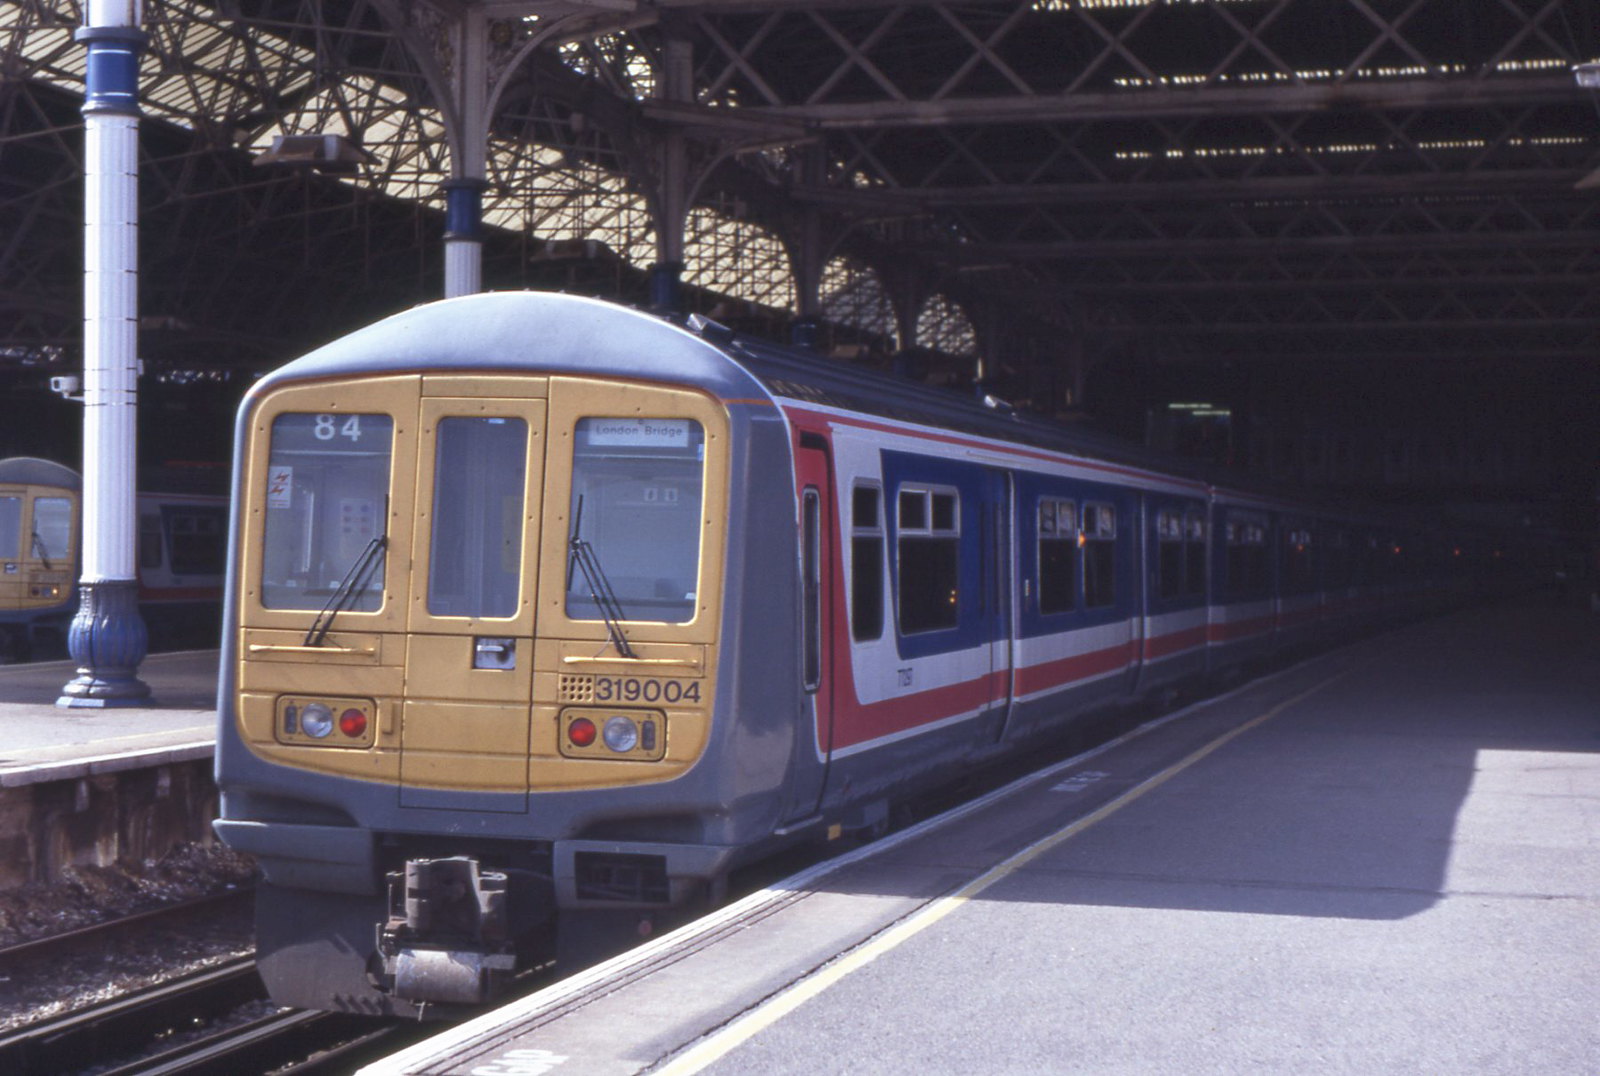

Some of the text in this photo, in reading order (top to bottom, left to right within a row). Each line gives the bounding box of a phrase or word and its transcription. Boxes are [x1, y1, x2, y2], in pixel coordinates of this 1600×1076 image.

[314, 414, 362, 441] 84
[595, 425, 684, 438] London Bridge
[596, 677, 701, 703] 319004
